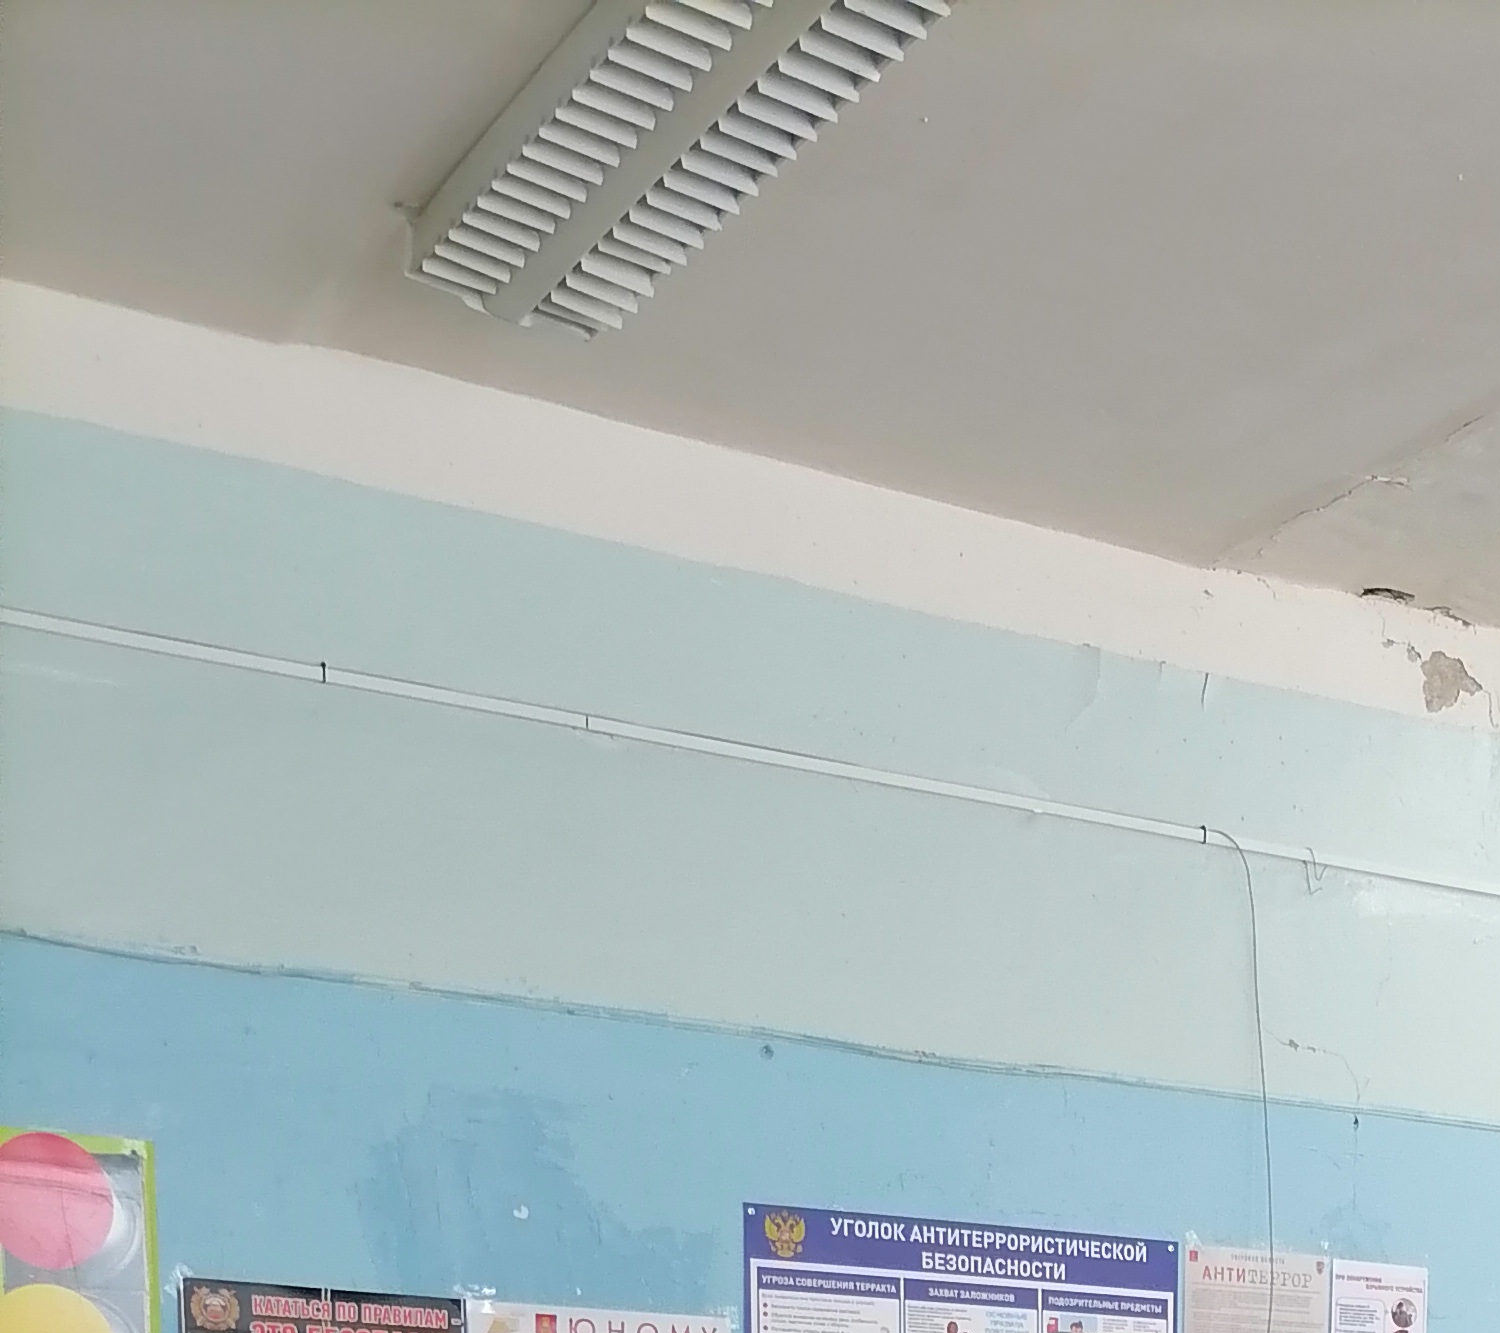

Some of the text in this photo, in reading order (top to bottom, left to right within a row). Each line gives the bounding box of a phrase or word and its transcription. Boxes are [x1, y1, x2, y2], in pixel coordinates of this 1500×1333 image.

[830, 1217, 1147, 1263] УГОЛОК АНТИТЕРРОРИСТИЧЕСКОЙ
[922, 1252, 1066, 1280] БЕЗОПАСНОСТИ
[1202, 1265, 1312, 1288] АНТИТЕРРОР
[762, 1275, 794, 1286] УГРОЗА
[796, 1277, 854, 1291] СОВЕРШЕНИЯ
[928, 1287, 1015, 1303] ЗАХВАТ ЗАЛОЖНИКОВ
[1048, 1296, 1162, 1314] ПОДОЗРИТЕЛЬНЫЕ ПРЕДМЕТЫ
[252, 1295, 331, 1320] КАТАТЬСЯ
[337, 1302, 358, 1323] ПО
[362, 1305, 448, 1329] ПРАВИЛАМ
